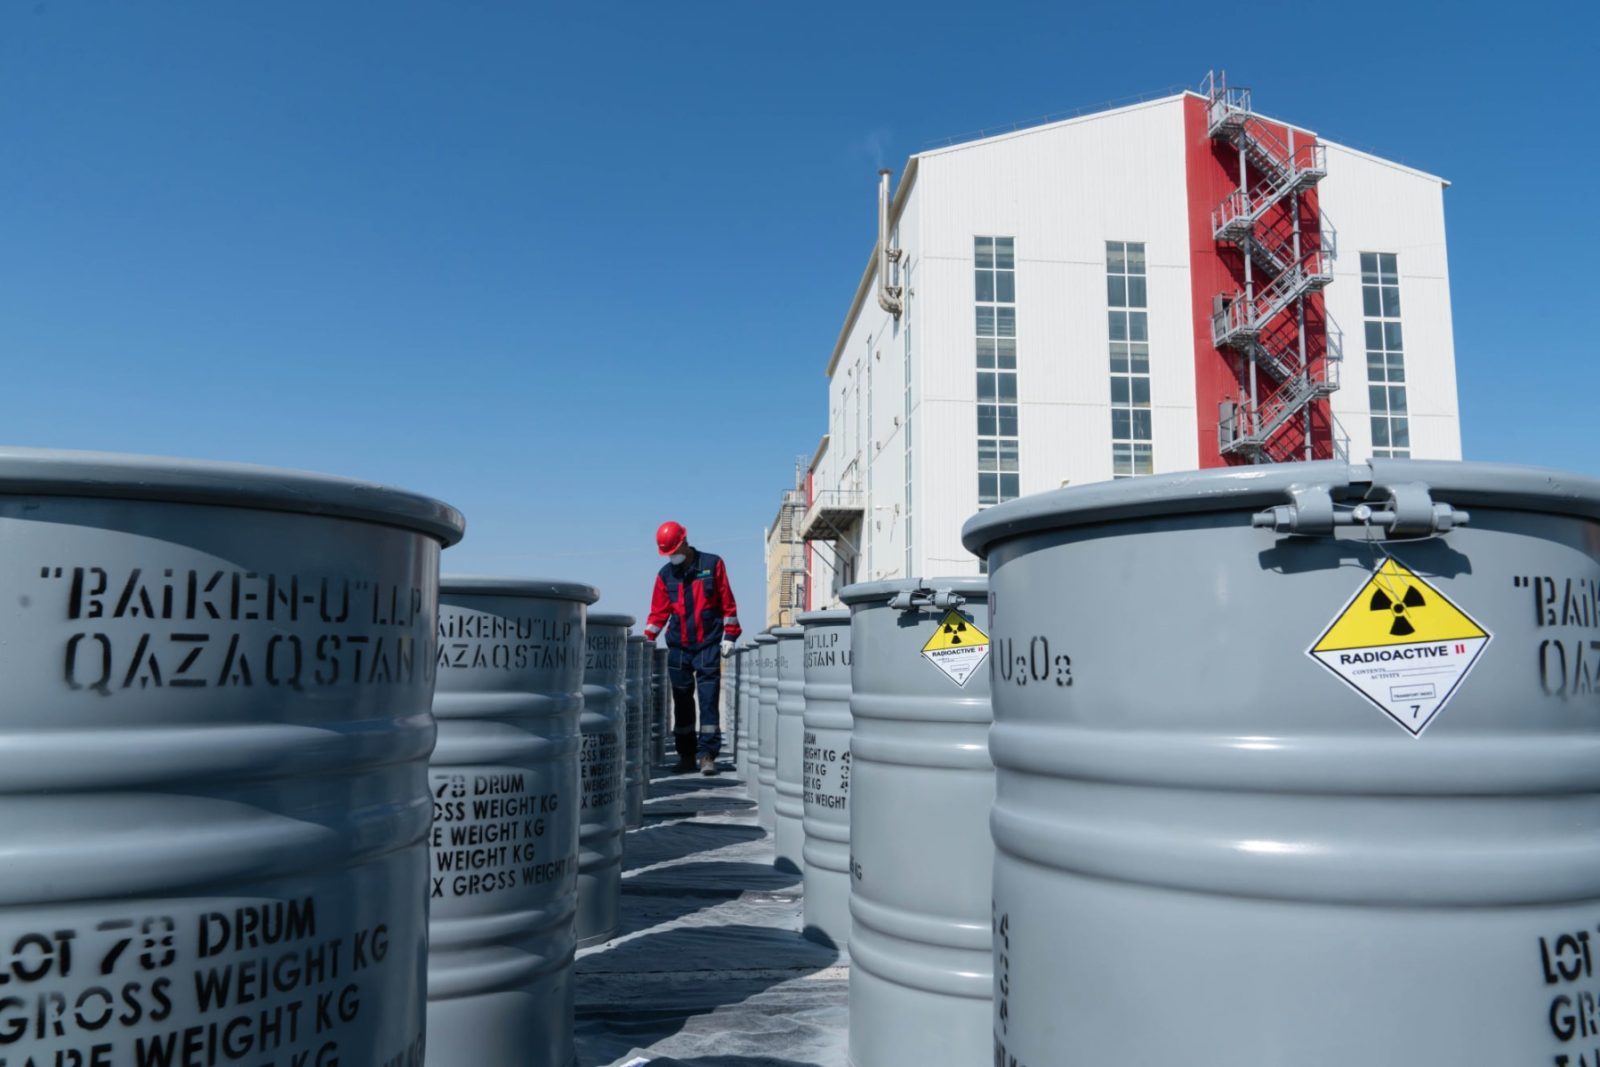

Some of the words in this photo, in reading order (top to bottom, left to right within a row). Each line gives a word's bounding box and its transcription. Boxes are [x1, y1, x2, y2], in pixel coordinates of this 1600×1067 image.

[65, 633, 414, 695] QAZAQSTAN
[437, 643, 567, 670] AZAQSTAN
[932, 647, 976, 658] RADIOACTIVE
[1340, 645, 1449, 665] RADIOACTIVE
[1455, 644, 1466, 654] II
[1410, 705, 1420, 718] 7
[823, 749, 836, 762] KG
[816, 764, 827, 776] KG
[474, 774, 524, 796] DRUM
[433, 802, 465, 821] OSS
[473, 796, 537, 820] WEIGHT
[540, 794, 558, 812] KG
[450, 821, 519, 847] WEIGHT
[523, 819, 545, 837] KG
[436, 846, 508, 872] WEIGHT
[513, 844, 535, 863] KG
[452, 871, 516, 896] GROSS
[96, 916, 176, 975] 78
[197, 897, 316, 959] DRUM
[1538, 930, 1592, 984] LOT
[0, 976, 173, 1044] GROSS
[194, 938, 343, 1013] WEIGHT
[352, 923, 389, 971] KG
[135, 1001, 302, 1067] WEIGHT
[315, 984, 361, 1034] KG
